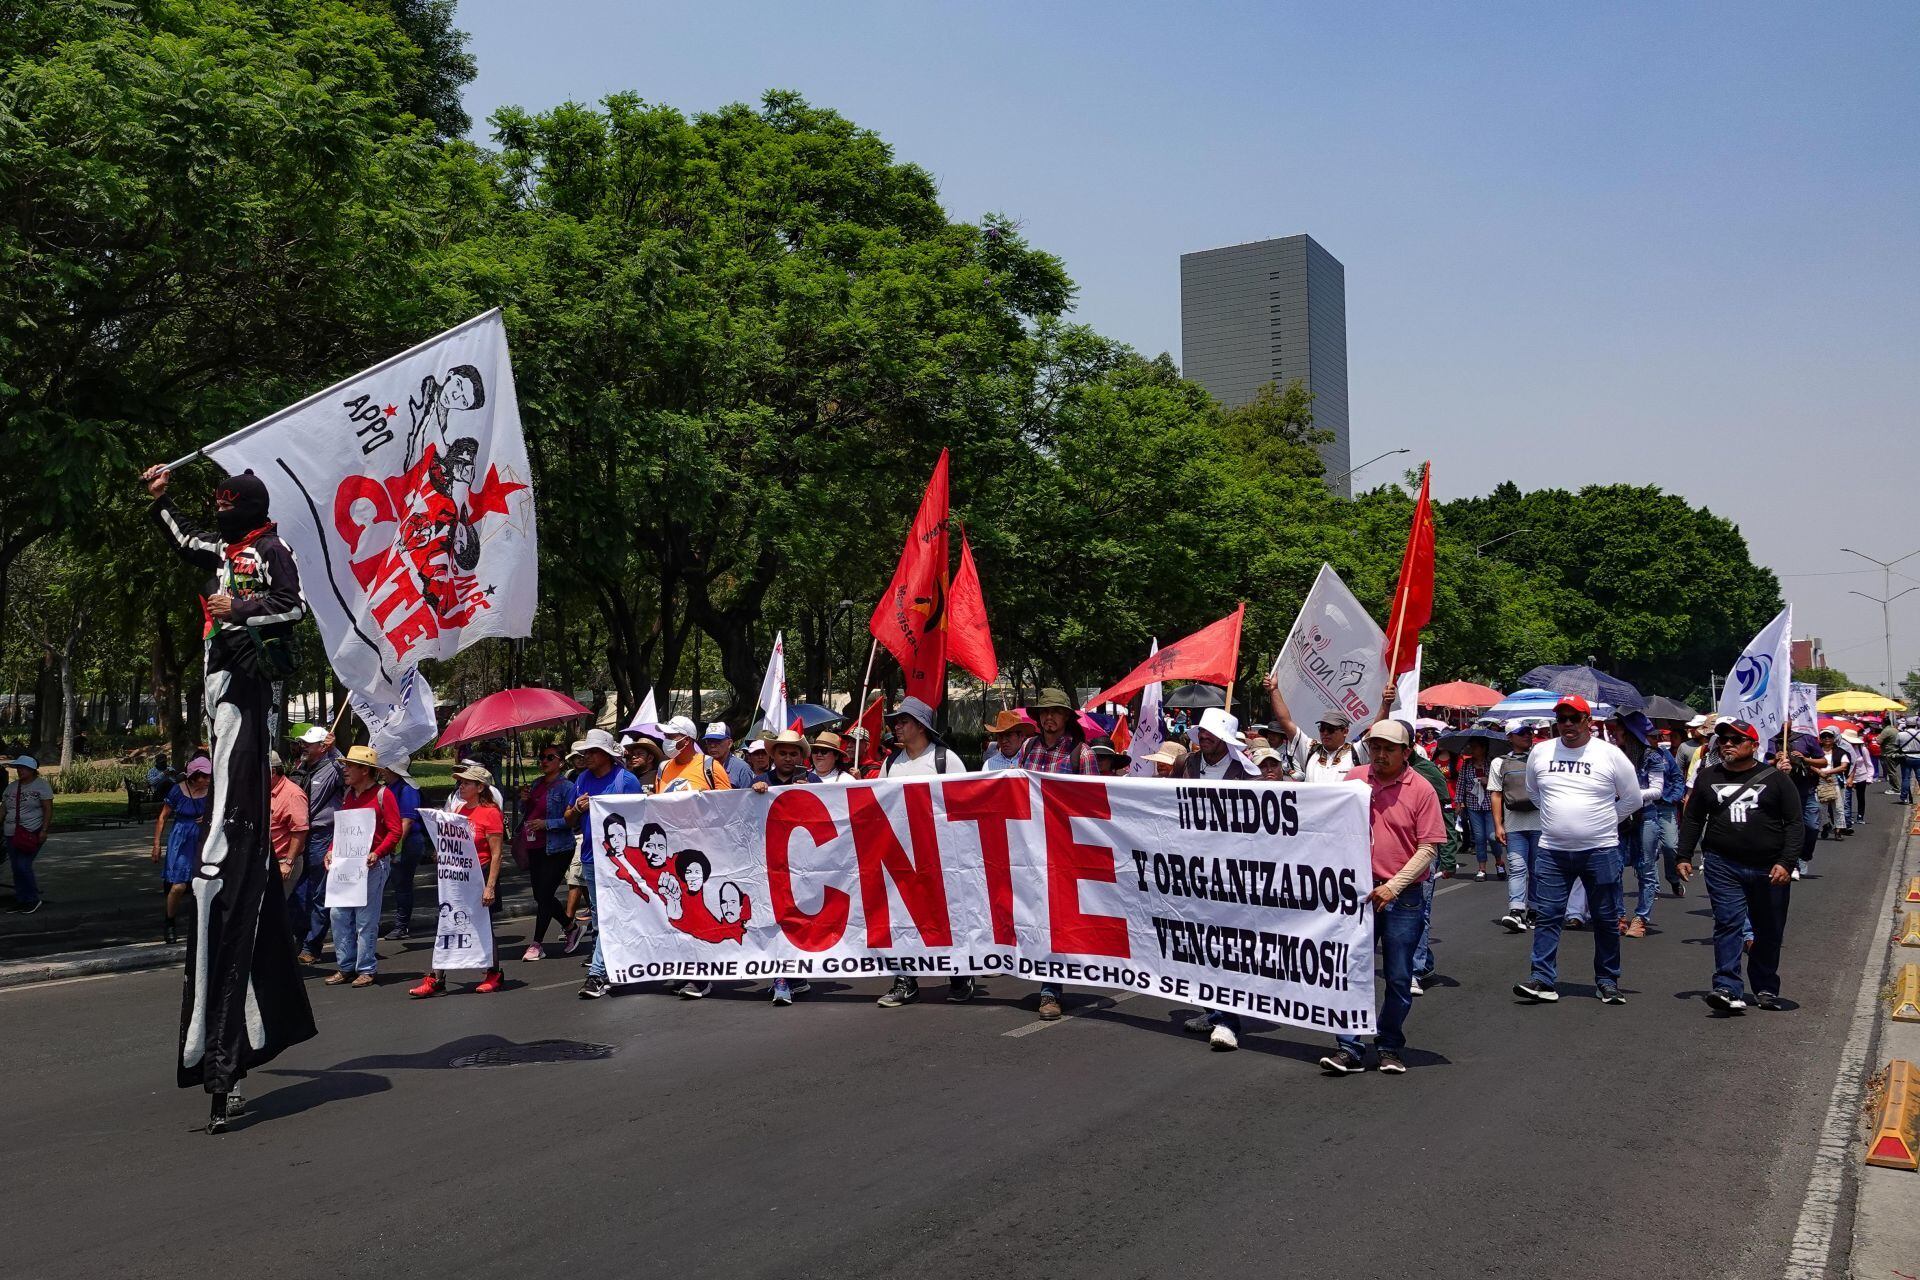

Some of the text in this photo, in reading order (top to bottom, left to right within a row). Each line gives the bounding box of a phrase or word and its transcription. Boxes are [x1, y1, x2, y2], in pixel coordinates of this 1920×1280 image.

[343, 393, 394, 455] APPO
[335, 474, 439, 663] CNTE
[1548, 760, 1592, 775] LEVI'S
[765, 776, 1131, 959] CNTE
[1131, 849, 1366, 924] Y ORGANIZADOS,
[745, 958, 814, 974] QUIEN
[822, 955, 960, 975] GOBIERNE,
[969, 953, 1014, 971] LOS
[1019, 957, 1151, 989] DERECHOS
[1159, 975, 1190, 997] SE
[1198, 982, 1368, 1029] DEFIENDEN!!
[1152, 916, 1349, 991] VENCEREMOS!!
